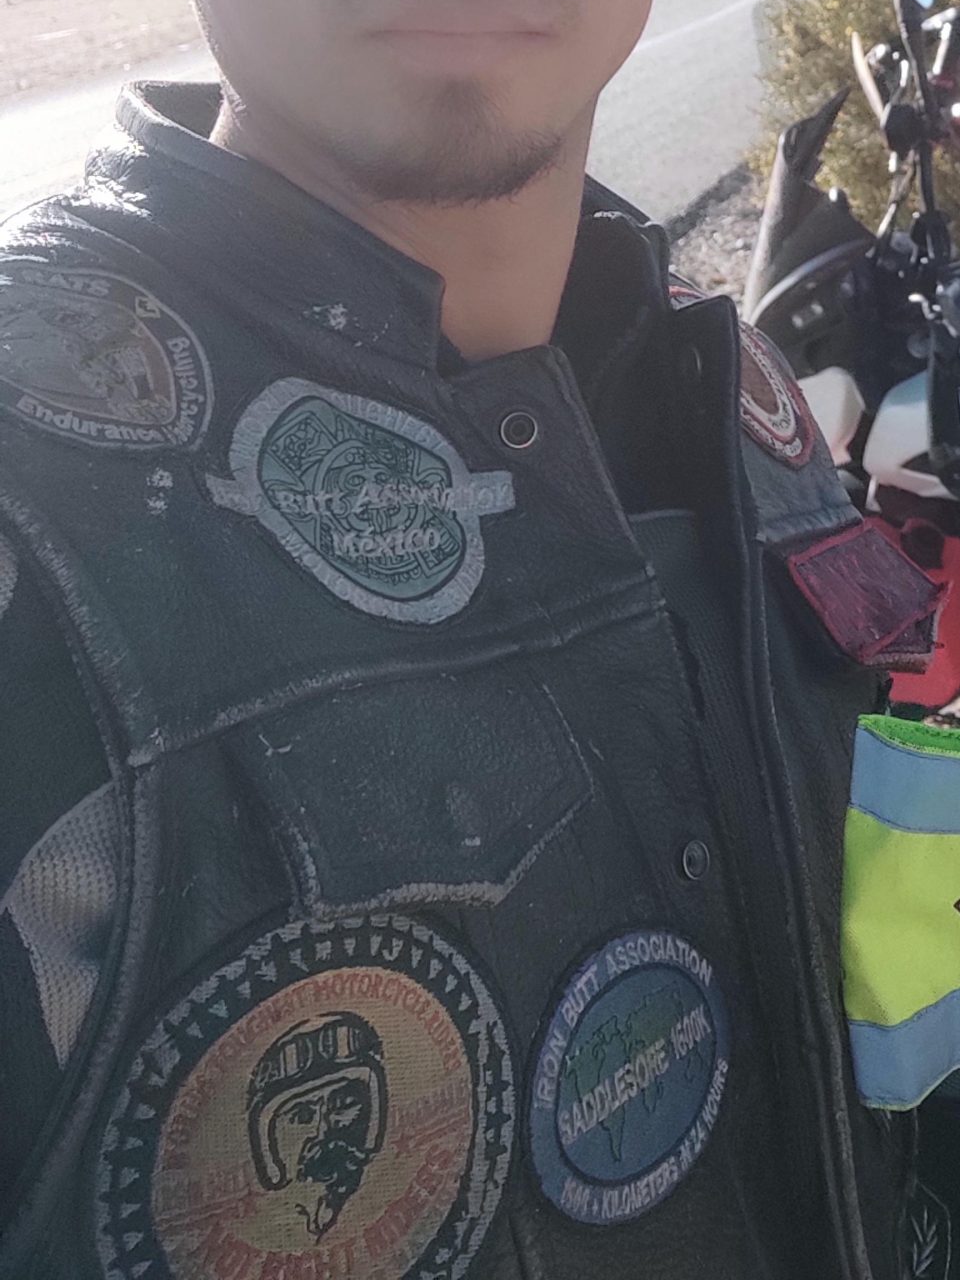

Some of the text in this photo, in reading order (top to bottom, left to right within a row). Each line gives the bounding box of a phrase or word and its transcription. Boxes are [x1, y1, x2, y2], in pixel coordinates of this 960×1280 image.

[534, 935, 713, 1110] IRON BUTT ASSOCIATION
[557, 1038, 669, 1147] SADDLESORE
[600, 1156, 679, 1220] KILOMETERS
[701, 1058, 729, 1131] HOURS
